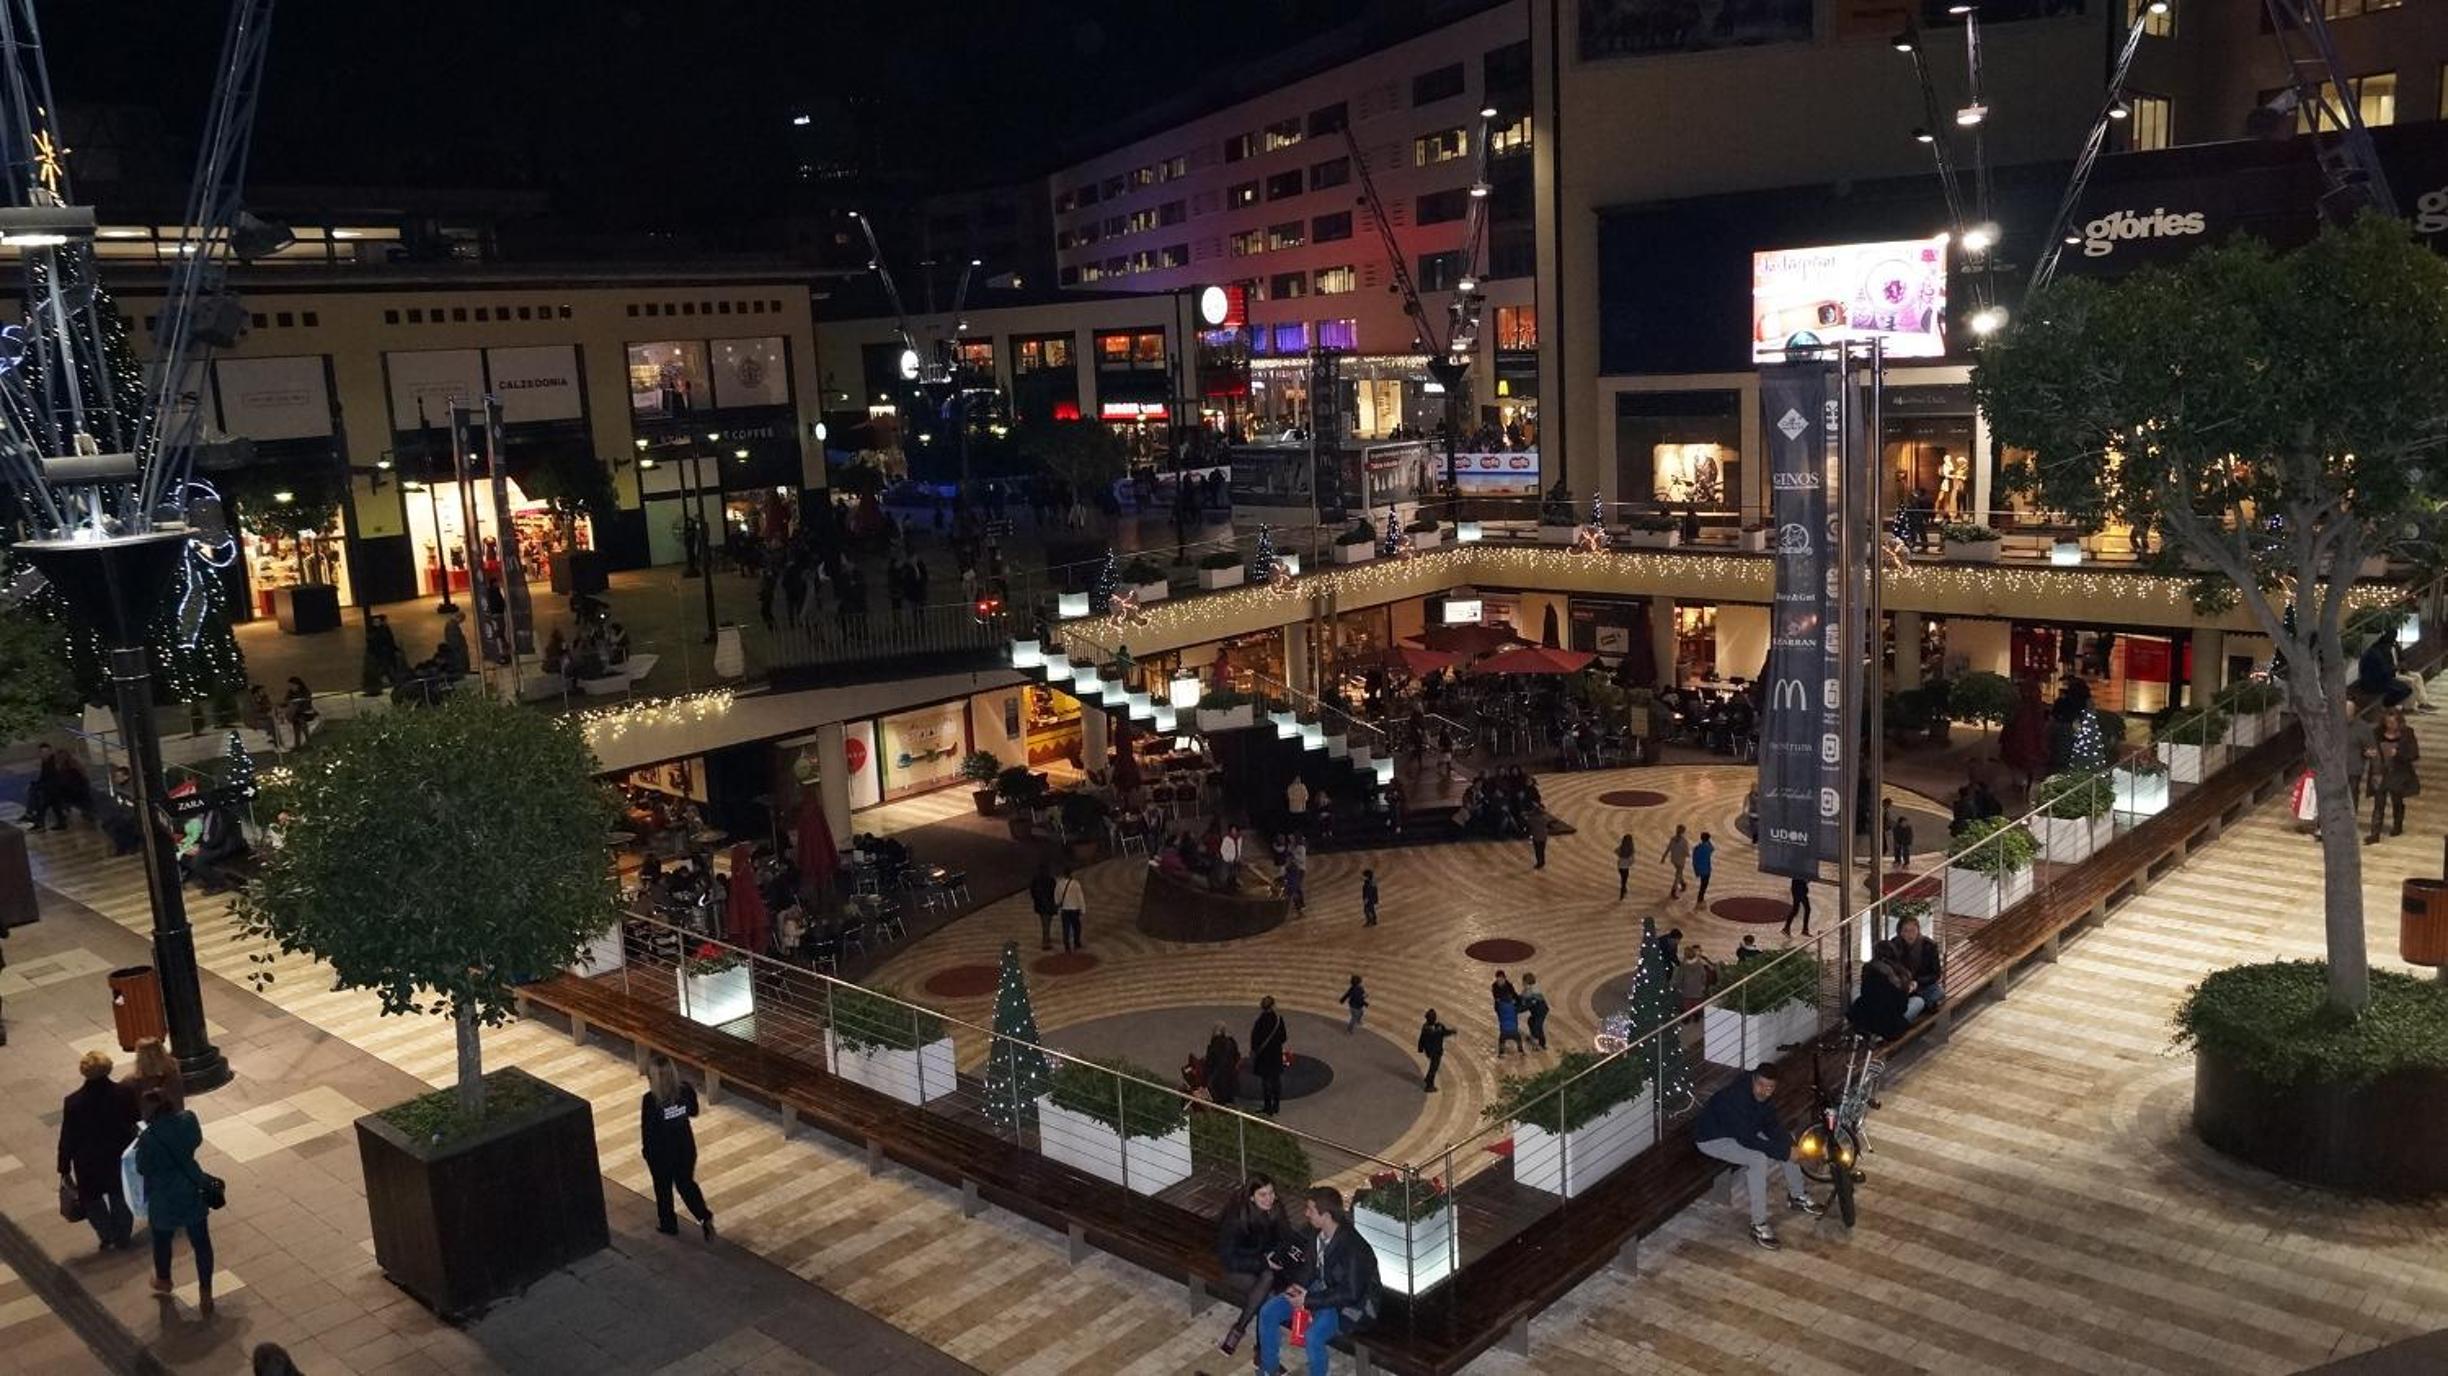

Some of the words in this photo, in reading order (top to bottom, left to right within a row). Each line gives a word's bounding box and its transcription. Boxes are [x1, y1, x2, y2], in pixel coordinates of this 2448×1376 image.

[498, 378, 568, 390] CALZEDONIA
[1773, 472, 1820, 486] GINOS
[176, 800, 205, 812] ZARA
[1769, 828, 1808, 842] UDON
